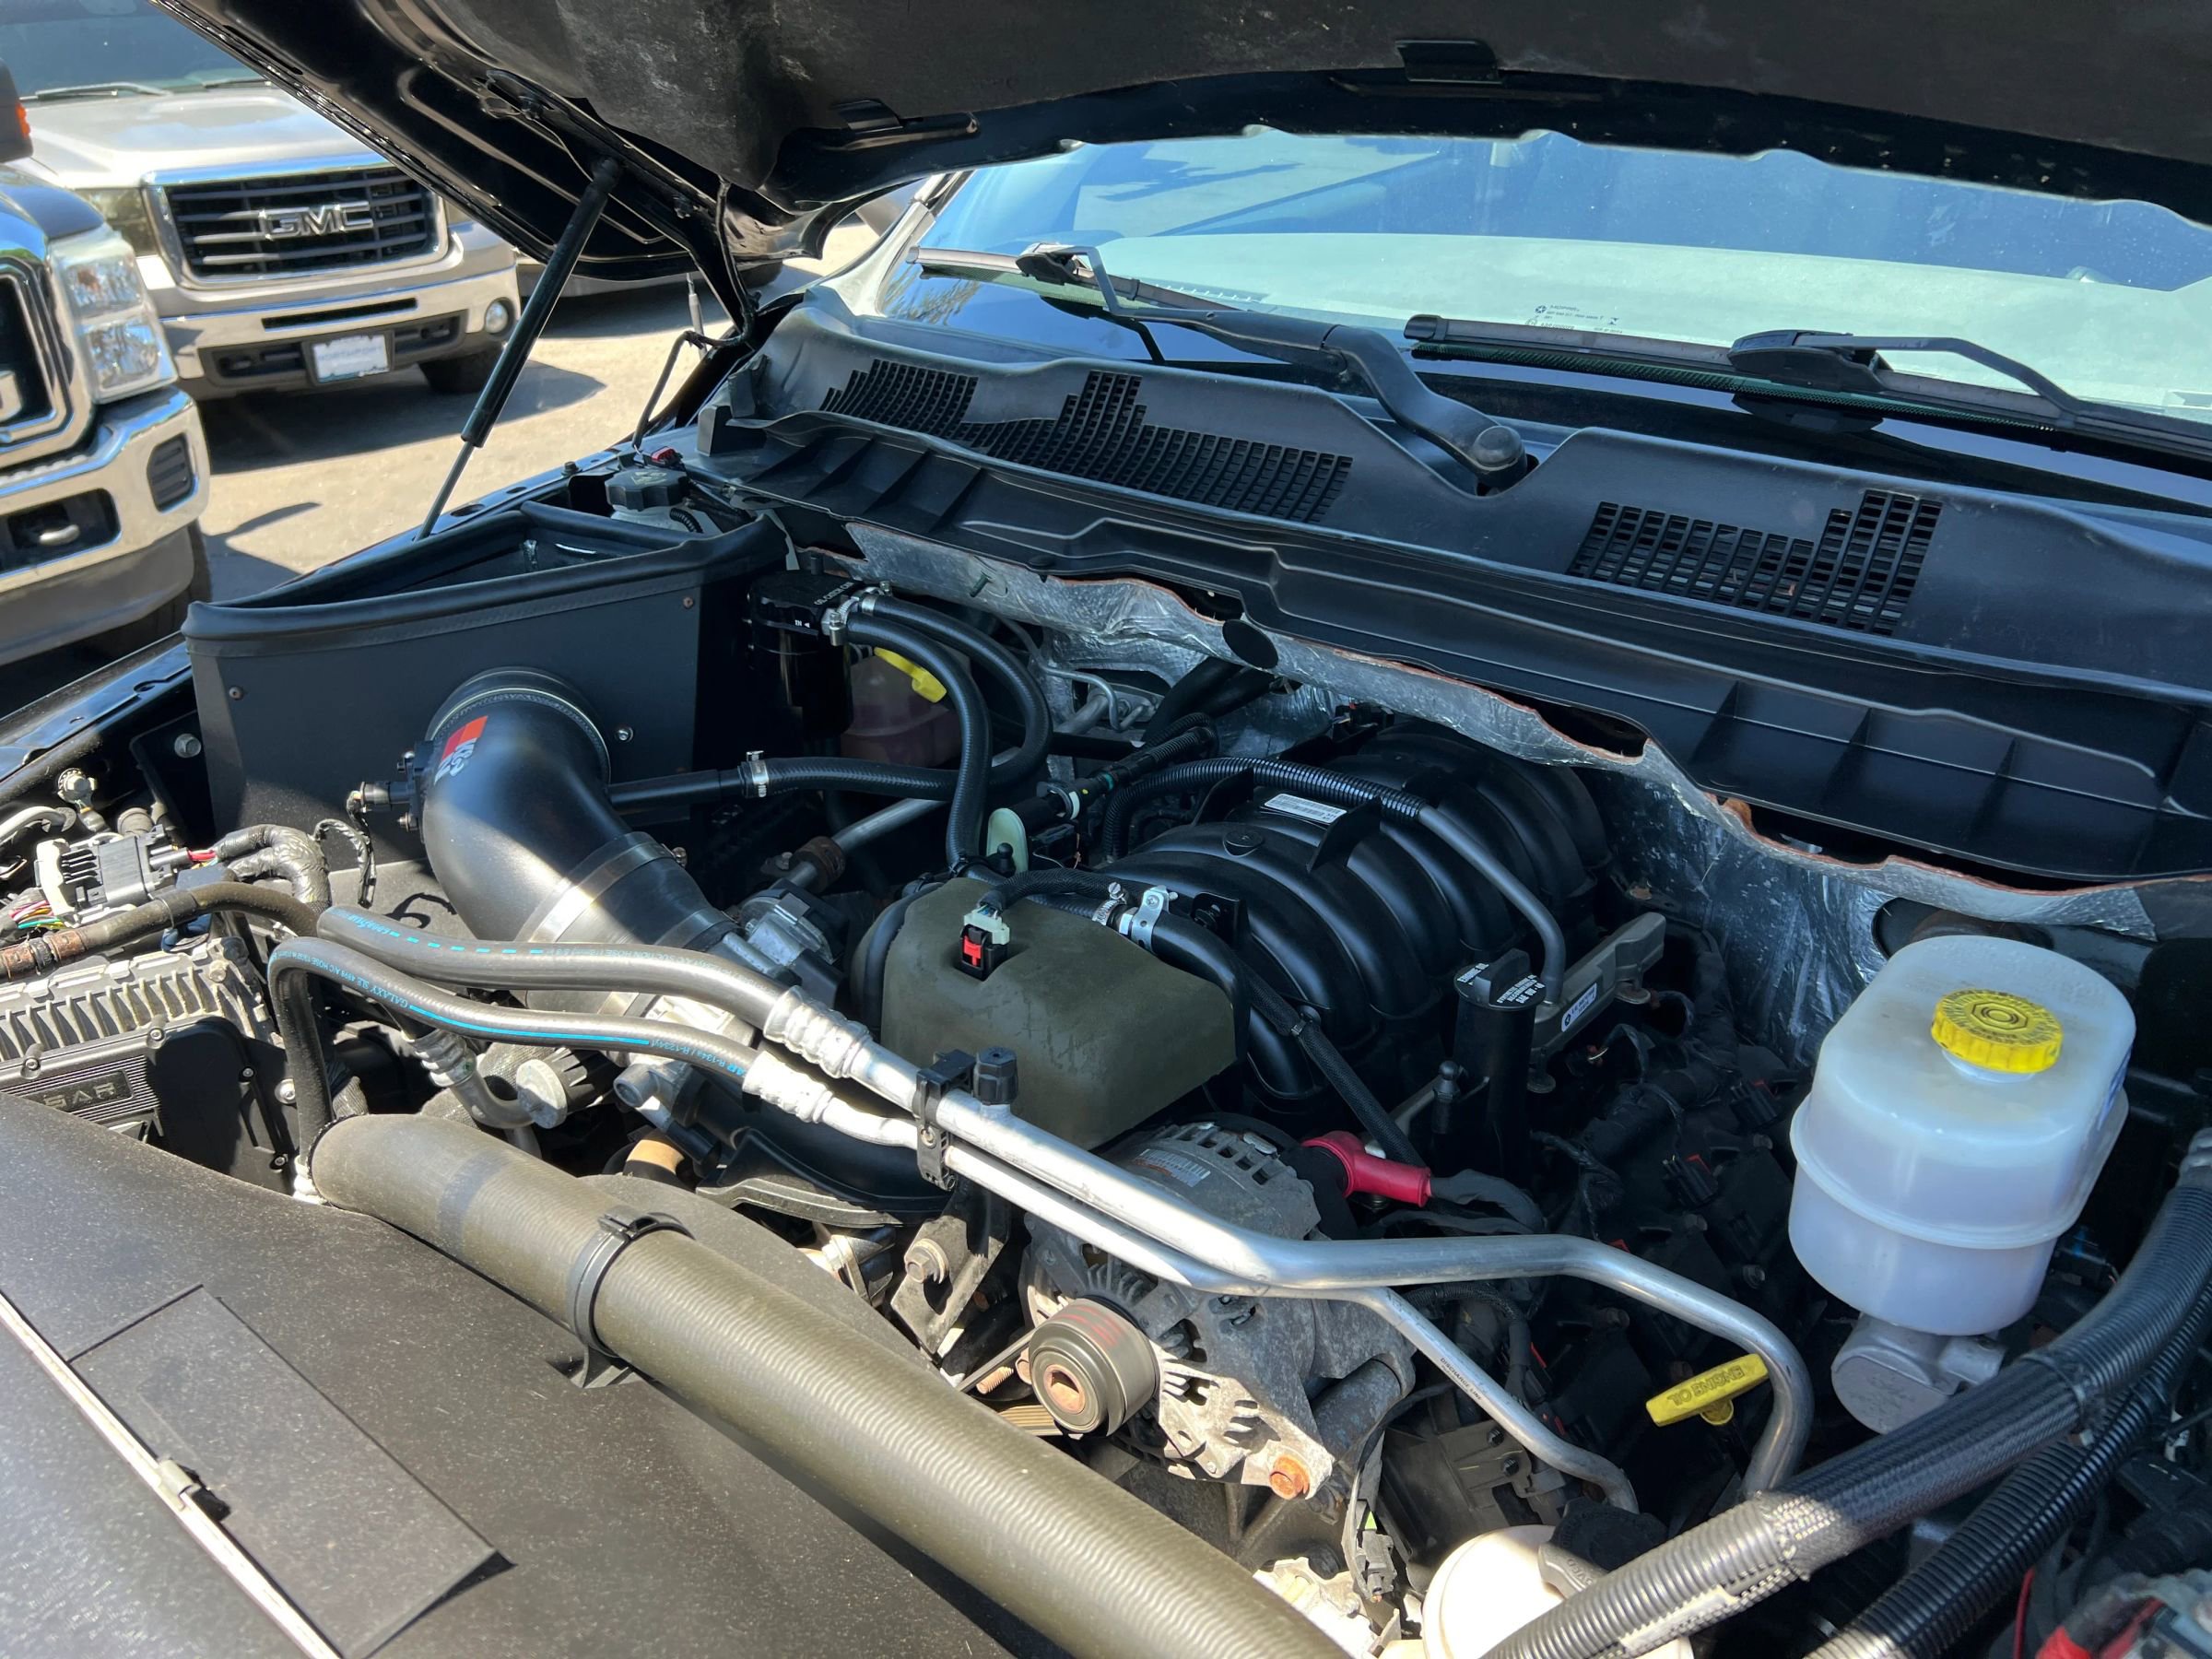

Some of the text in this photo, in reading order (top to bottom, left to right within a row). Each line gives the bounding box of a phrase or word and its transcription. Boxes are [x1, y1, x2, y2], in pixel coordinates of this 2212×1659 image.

[258, 201, 373, 241] GMC
[312, 957, 329, 971] HOSE
[370, 985, 408, 1008] GALAXY
[43, 1082, 117, 1107] SAR
[1666, 1365, 1746, 1406] ENGINE OIL
